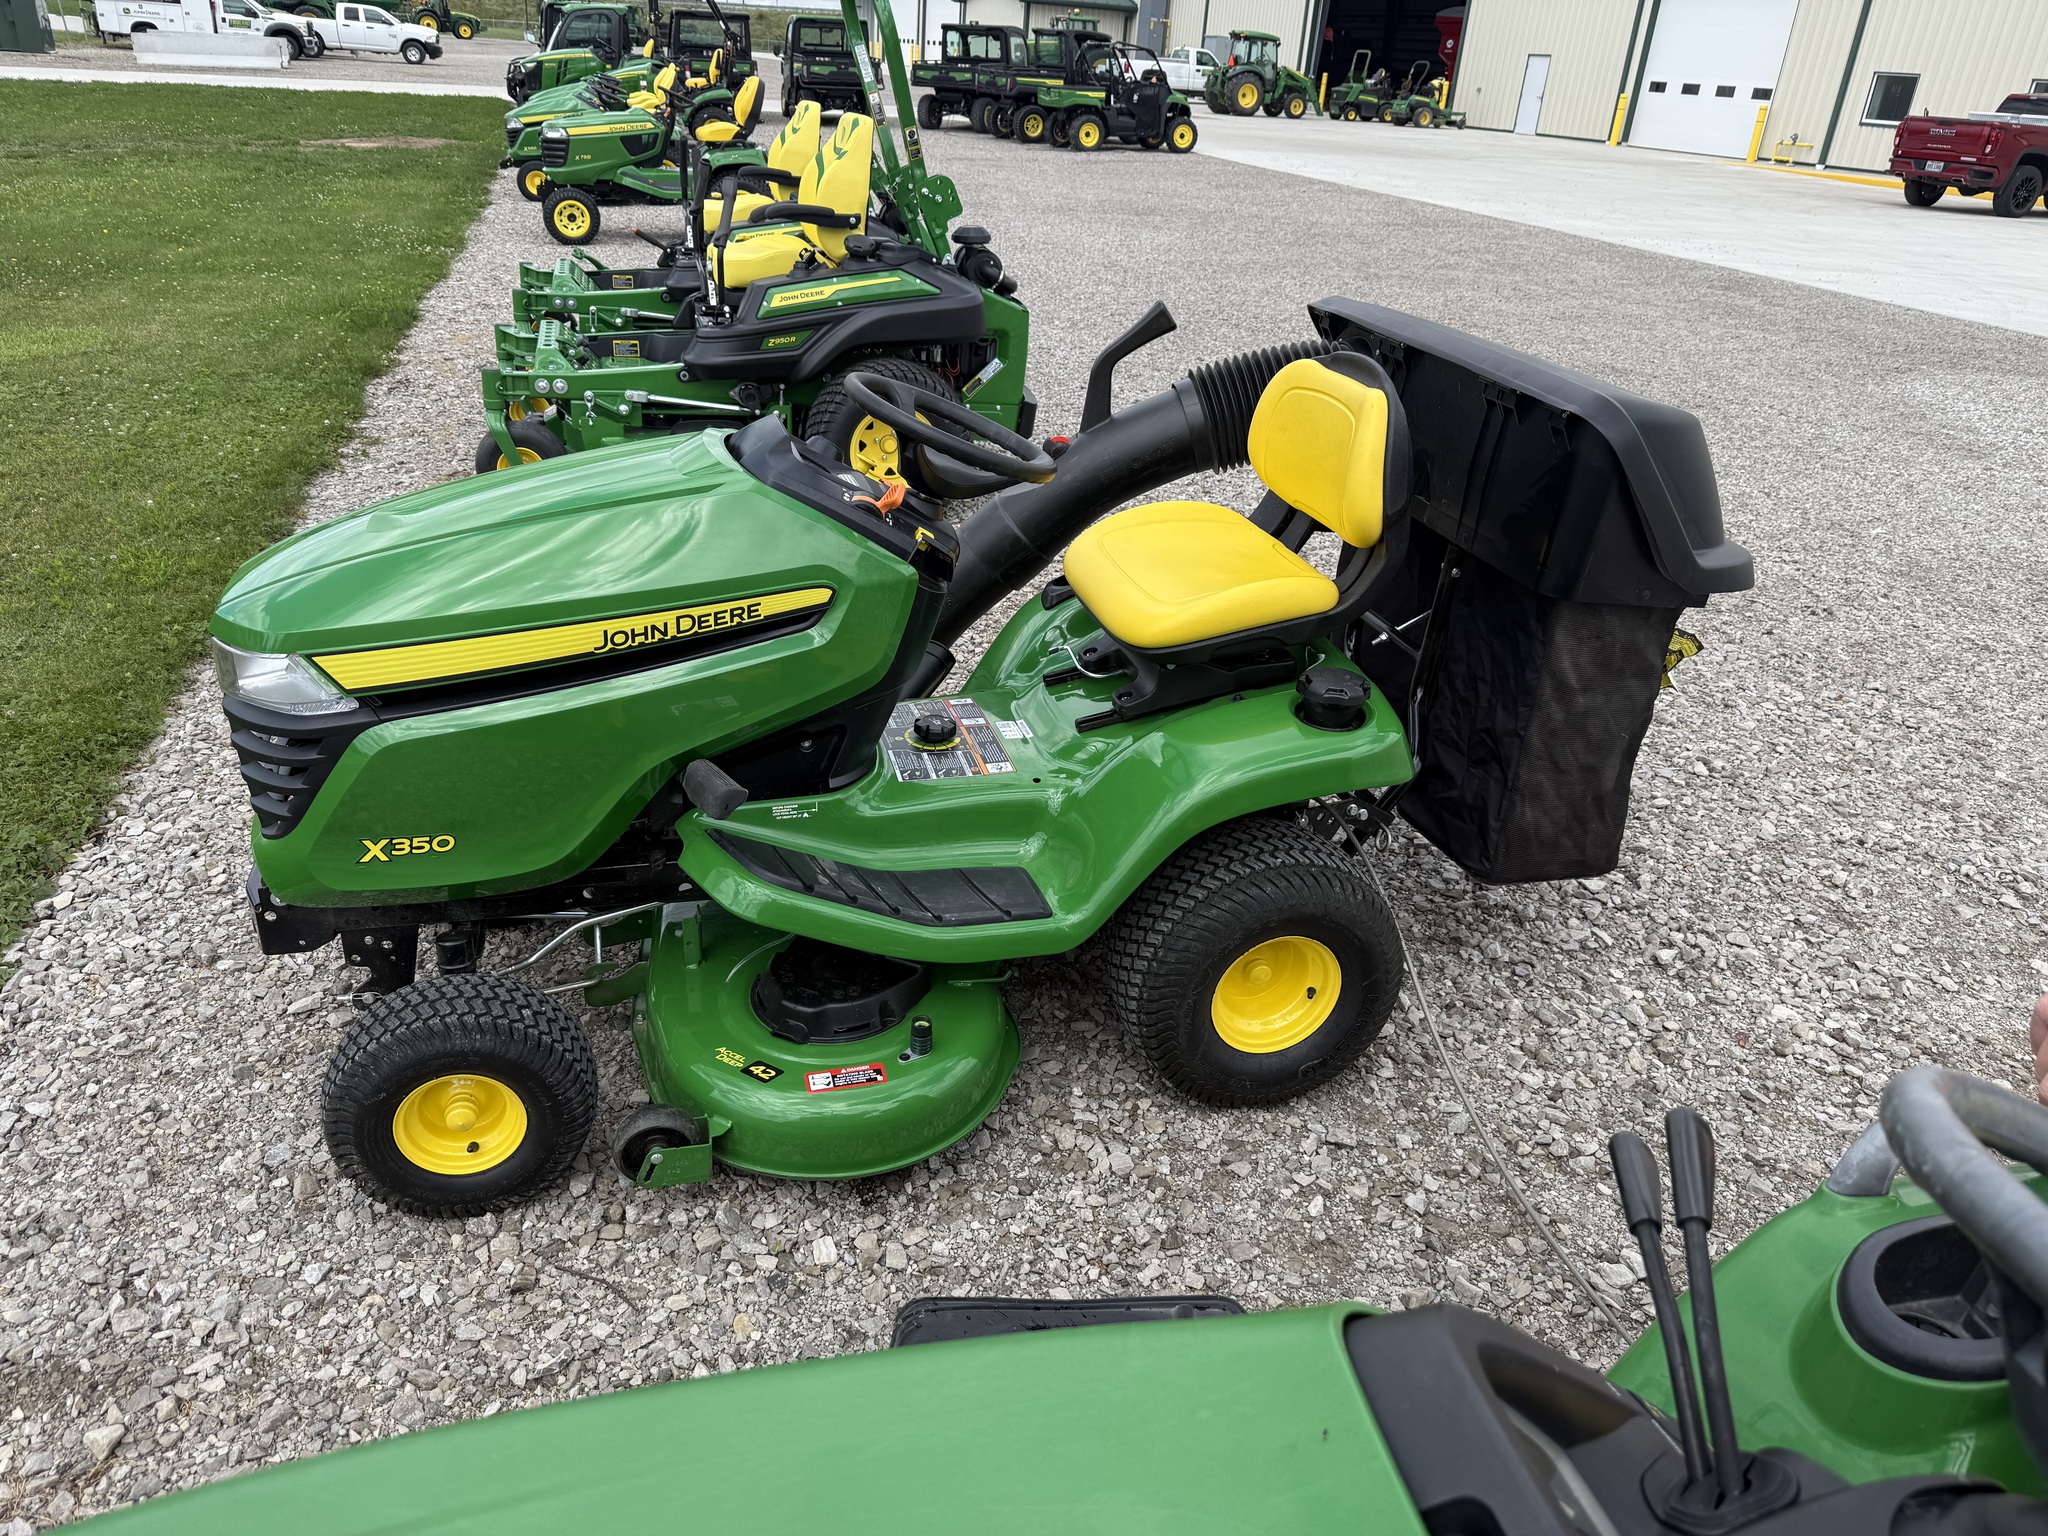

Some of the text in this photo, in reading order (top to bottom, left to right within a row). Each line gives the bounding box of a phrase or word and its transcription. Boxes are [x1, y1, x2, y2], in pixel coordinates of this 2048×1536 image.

[779, 290, 825, 303] JOHN DEERE
[768, 336, 796, 347] Z950R
[593, 602, 763, 652] JOHN DEERE
[356, 834, 456, 864] X350
[715, 1046, 746, 1063] ACCEL
[715, 1053, 744, 1068] DEEP
[748, 1065, 777, 1080] 42
